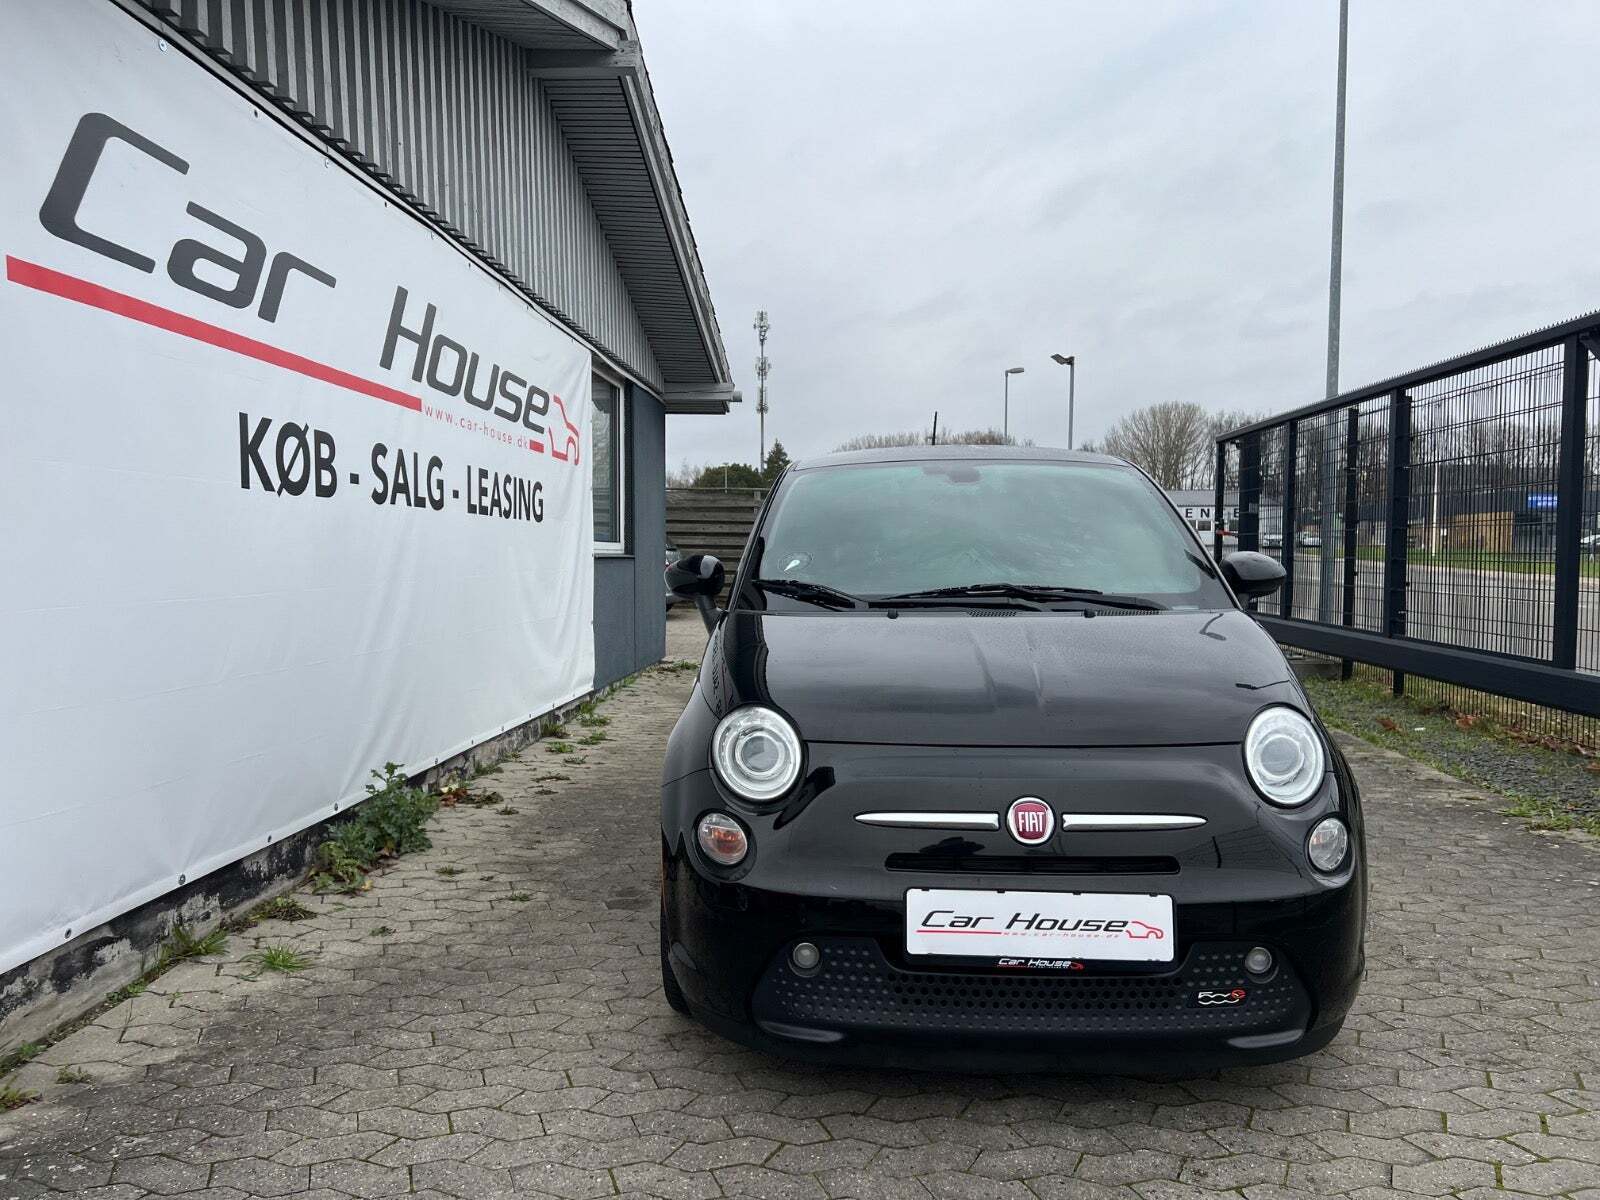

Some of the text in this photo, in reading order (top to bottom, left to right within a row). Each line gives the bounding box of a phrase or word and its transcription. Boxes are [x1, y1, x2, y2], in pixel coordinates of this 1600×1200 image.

[39, 112, 550, 434] Car House
[424, 405, 528, 449] www.car-house.dk
[239, 412, 338, 498] KØB
[371, 443, 444, 512] SALG
[467, 464, 544, 523] LEASING
[1018, 811, 1044, 832] FIAT
[921, 910, 1128, 932] Car House
[998, 957, 1071, 967] Car House
